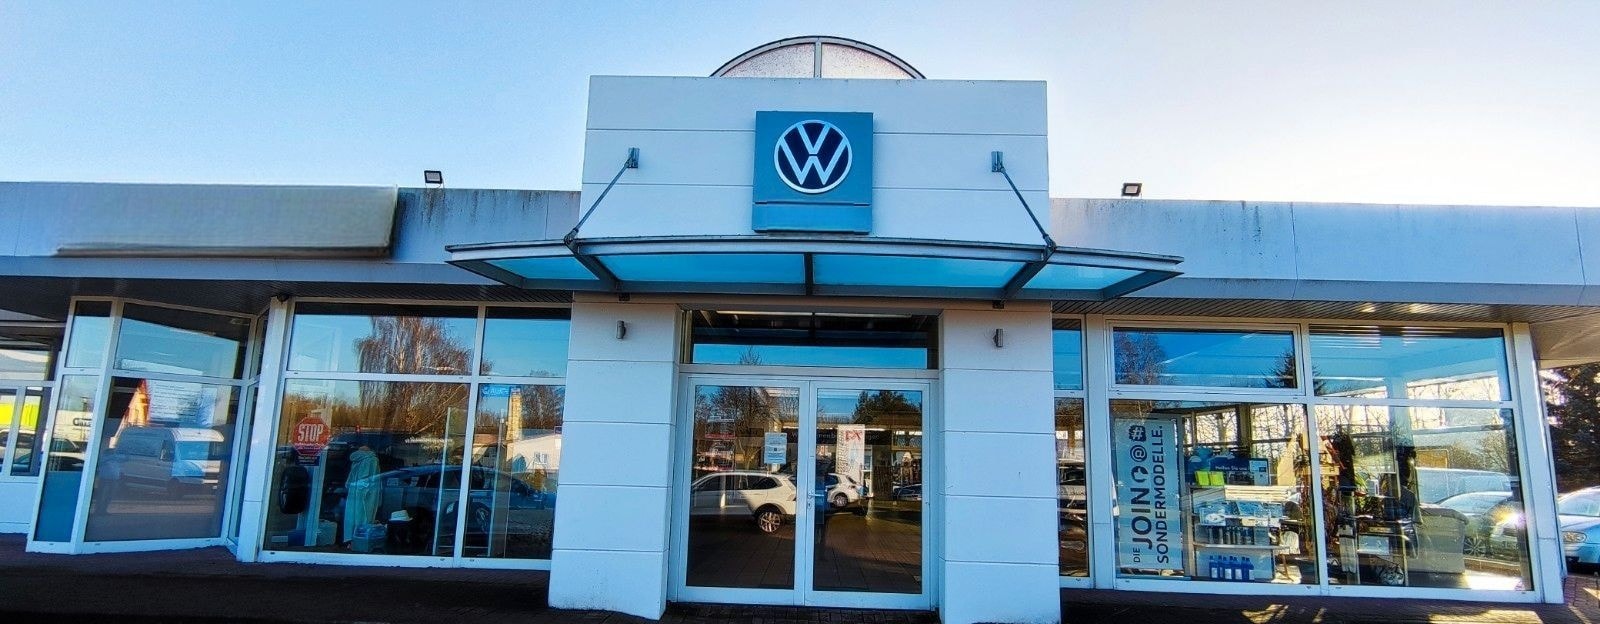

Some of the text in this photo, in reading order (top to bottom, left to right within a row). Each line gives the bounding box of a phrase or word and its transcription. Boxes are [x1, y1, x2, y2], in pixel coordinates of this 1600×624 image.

[298, 423, 325, 442] STOP
[1152, 425, 1169, 564] SONDERMODELLE.
[1130, 487, 1152, 550] JOIN
[1133, 548, 1141, 563] DIE
